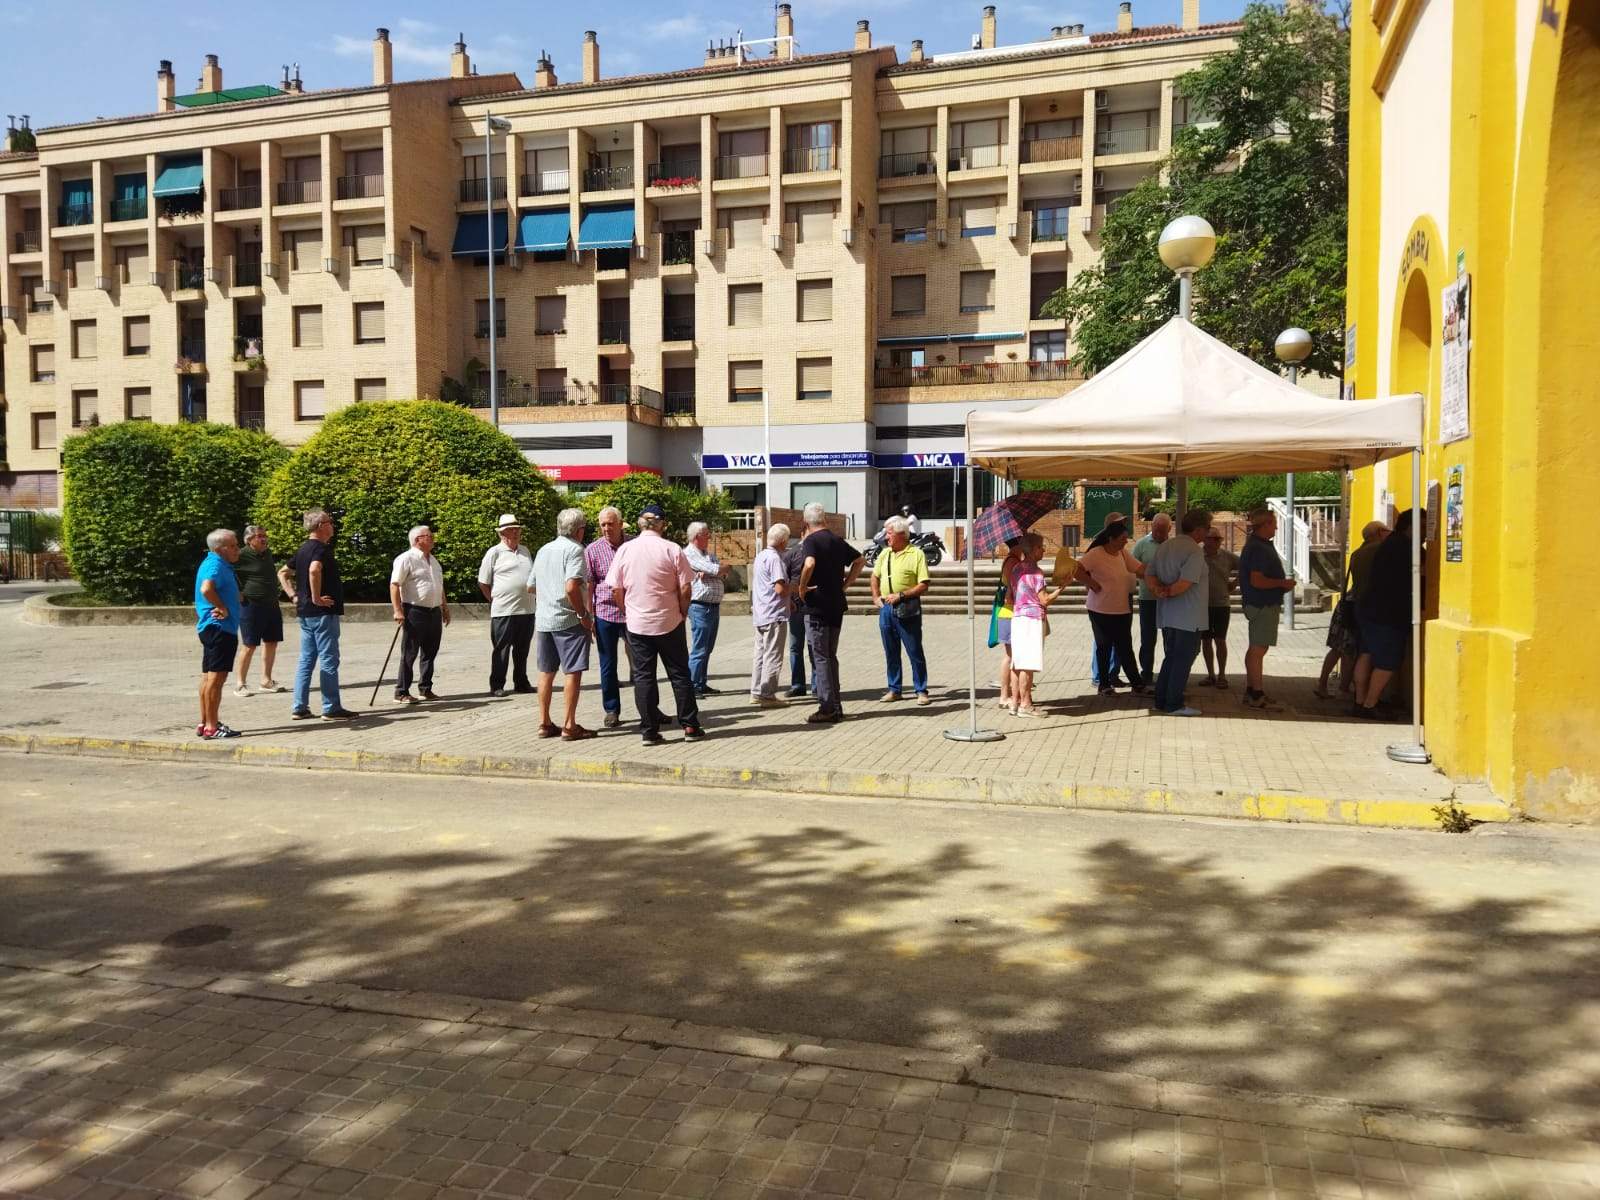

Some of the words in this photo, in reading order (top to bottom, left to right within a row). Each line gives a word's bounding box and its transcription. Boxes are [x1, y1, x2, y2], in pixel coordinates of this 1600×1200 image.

[1402, 230, 1429, 283] SOMBRA
[731, 455, 766, 467] YMCA
[913, 454, 952, 467] YMCA
